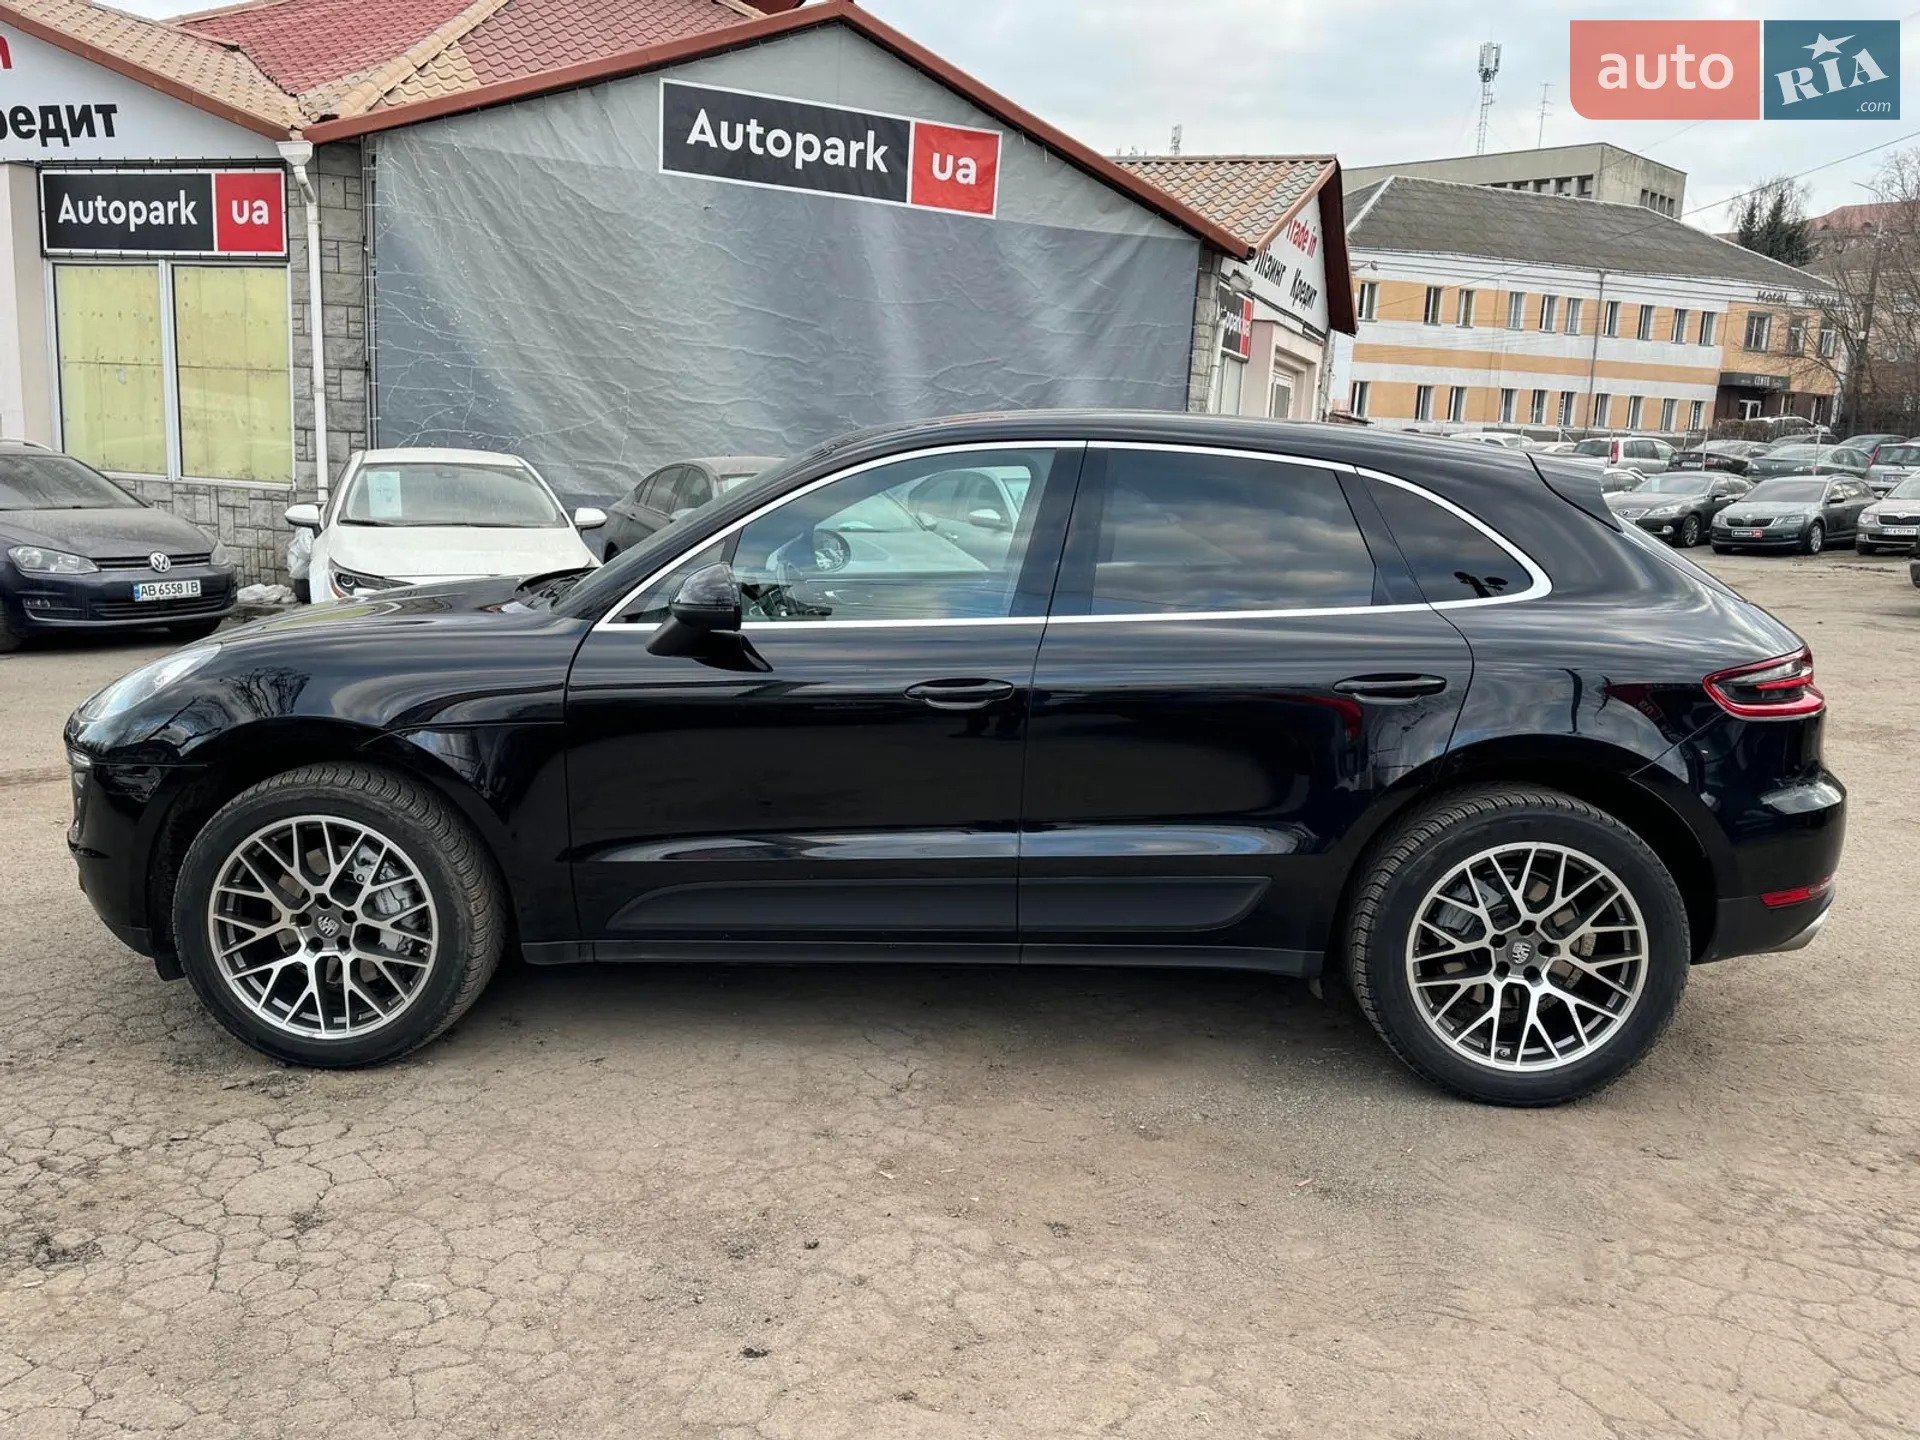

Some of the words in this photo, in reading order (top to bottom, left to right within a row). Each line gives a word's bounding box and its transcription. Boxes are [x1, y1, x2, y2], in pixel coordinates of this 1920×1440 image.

[686, 108, 889, 173] Autopark
[931, 152, 977, 185] ua
[58, 190, 198, 232] Autopark
[231, 199, 270, 226] ua
[141, 585, 156, 597] AB
[158, 583, 183, 595] 6558
